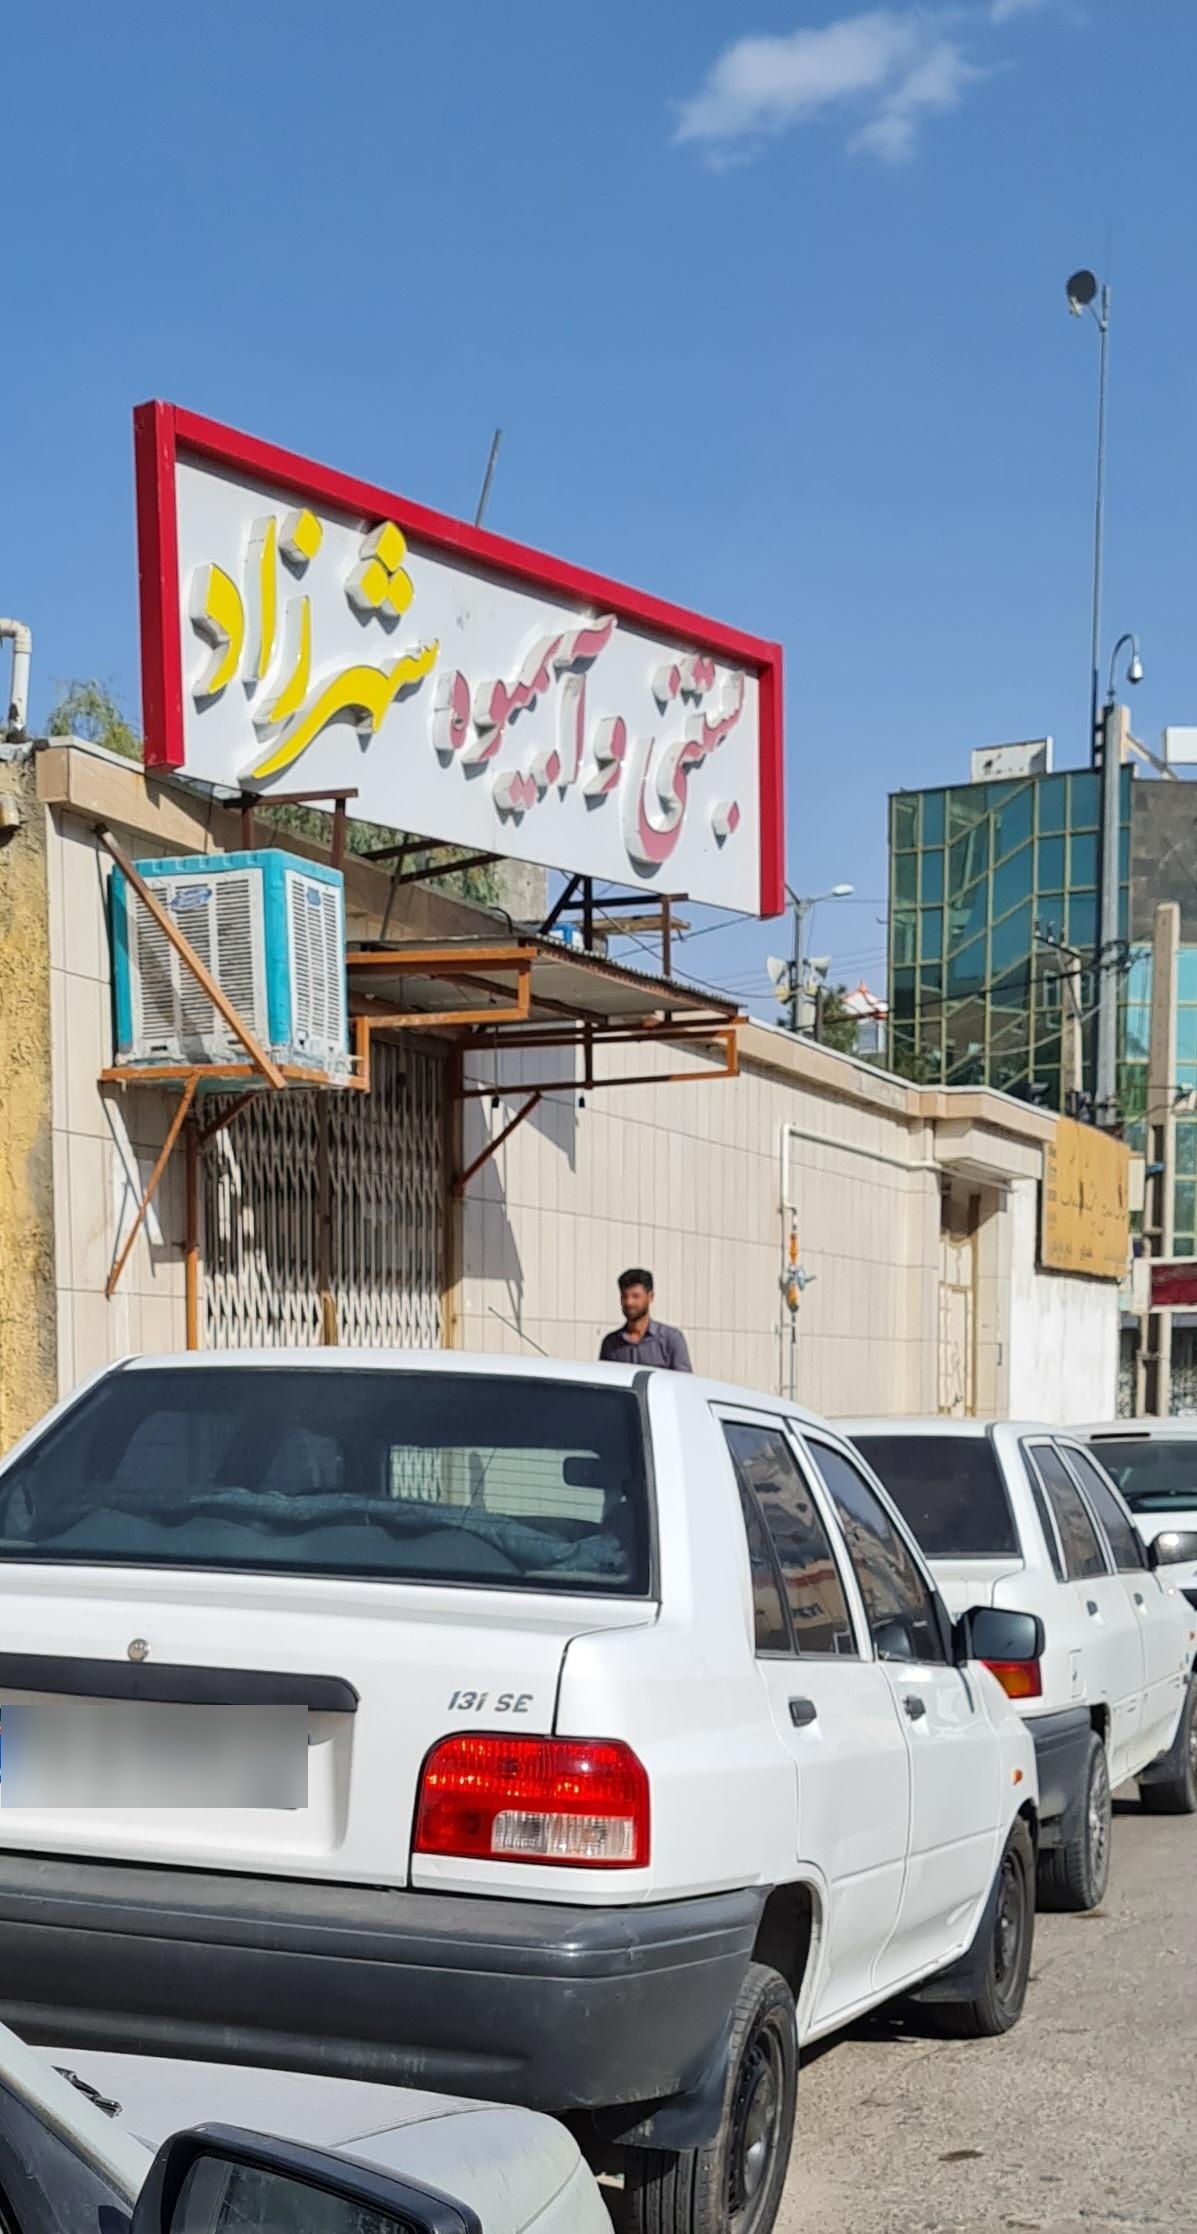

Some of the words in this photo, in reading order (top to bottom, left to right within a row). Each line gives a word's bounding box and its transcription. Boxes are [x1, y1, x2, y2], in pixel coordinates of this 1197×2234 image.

[191, 508, 439, 781] شهرزاد
[434, 614, 617, 811] آبمیوه
[584, 717, 625, 797] و
[625, 655, 744, 863] بستنی
[448, 1690, 489, 1712] 131
[494, 1693, 534, 1713] SE
